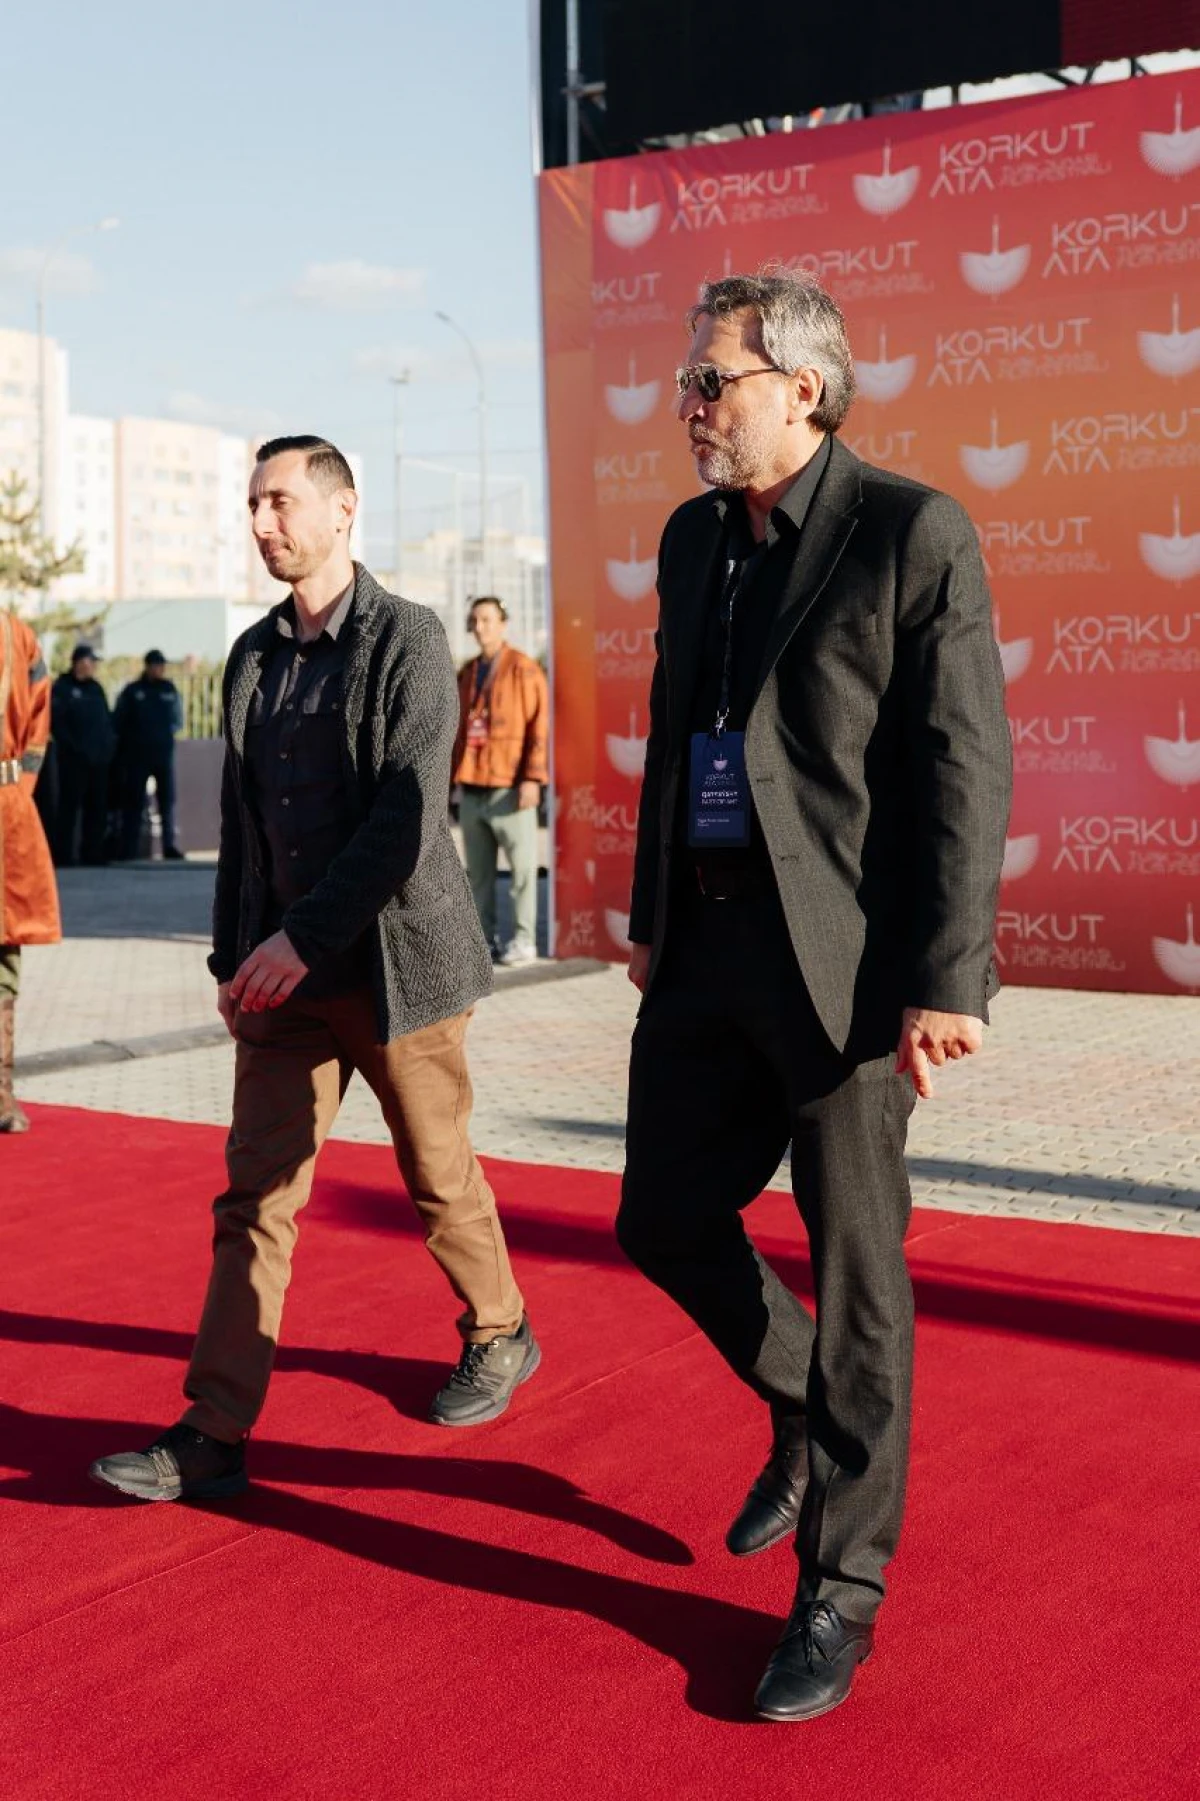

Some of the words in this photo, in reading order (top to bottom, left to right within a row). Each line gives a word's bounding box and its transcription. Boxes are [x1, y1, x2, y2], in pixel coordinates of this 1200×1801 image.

[938, 121, 1095, 169] KORKUT
[677, 163, 815, 204] KORKUT
[929, 166, 995, 198] ATA
[669, 203, 727, 233] ATA
[1041, 246, 1111, 279] ATA
[936, 317, 1092, 358] KORKUT
[926, 357, 993, 388] ATA
[1042, 446, 1111, 476] ATA
[1043, 645, 1115, 675] ATA
[1060, 815, 1198, 848] KORKU
[1052, 843, 1123, 874] ATA
